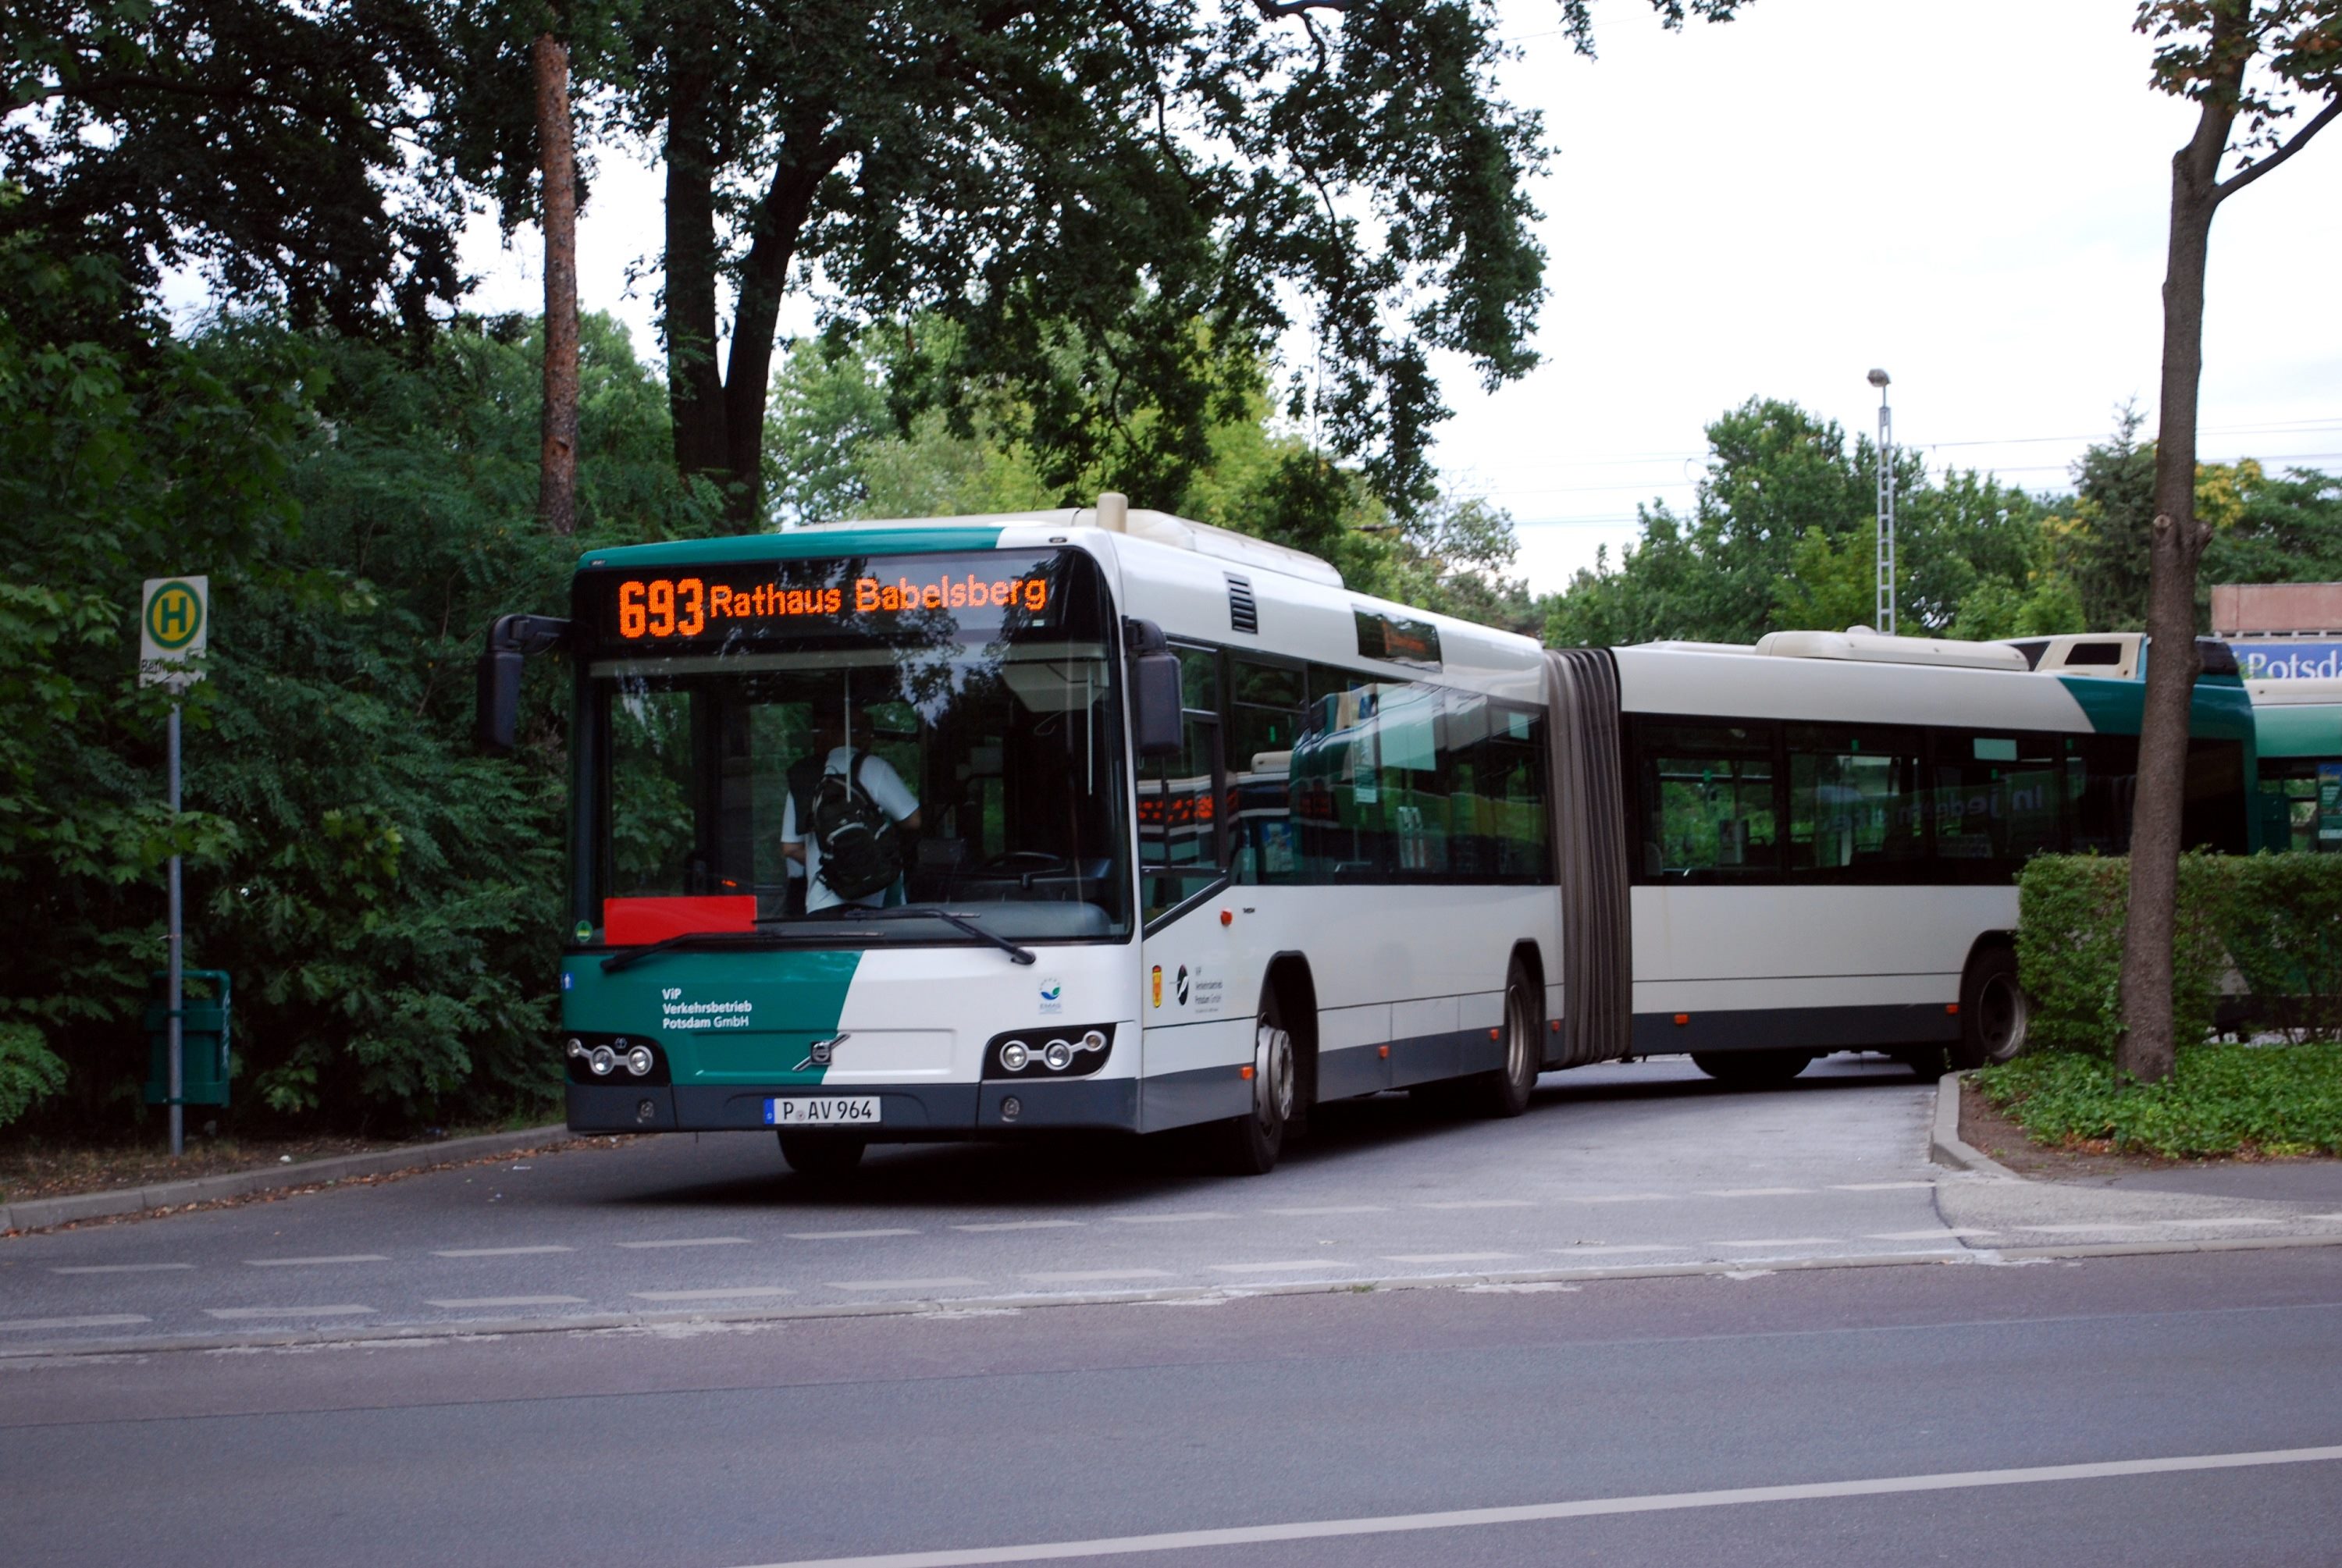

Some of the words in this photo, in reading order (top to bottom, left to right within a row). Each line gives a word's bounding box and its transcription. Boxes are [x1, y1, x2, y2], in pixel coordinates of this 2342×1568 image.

[619, 578, 705, 638] 693
[710, 582, 842, 617] Rathaus
[855, 574, 1047, 612] Babelsberg
[161, 596, 187, 634] H
[662, 987, 682, 1000] ViP
[662, 1000, 753, 1015] Verkehrsbetrieb
[663, 1016, 711, 1029] Potsdam
[714, 1015, 749, 1027] GmbH
[783, 1101, 794, 1120] P
[808, 1100, 831, 1119] AV
[837, 1100, 872, 1119] 964
